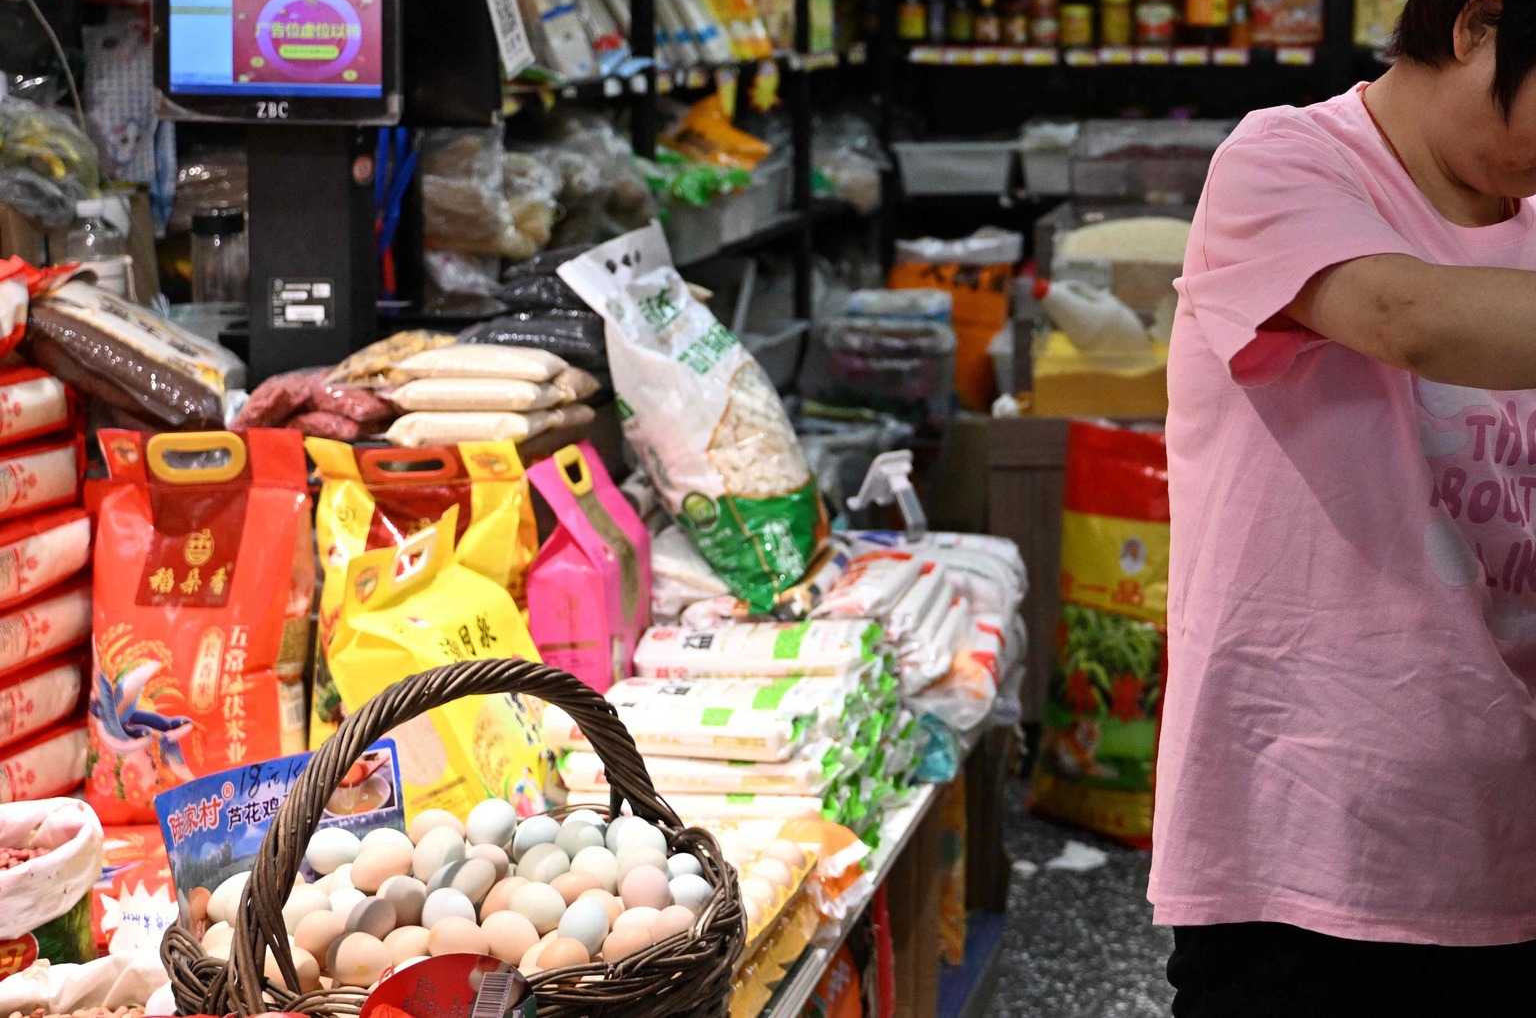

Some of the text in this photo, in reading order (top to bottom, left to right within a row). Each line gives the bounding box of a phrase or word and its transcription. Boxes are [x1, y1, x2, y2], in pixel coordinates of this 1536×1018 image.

[256, 101, 289, 119] ZBC
[168, 795, 223, 846] 陆家村
[227, 794, 290, 831] 芦花鸡
